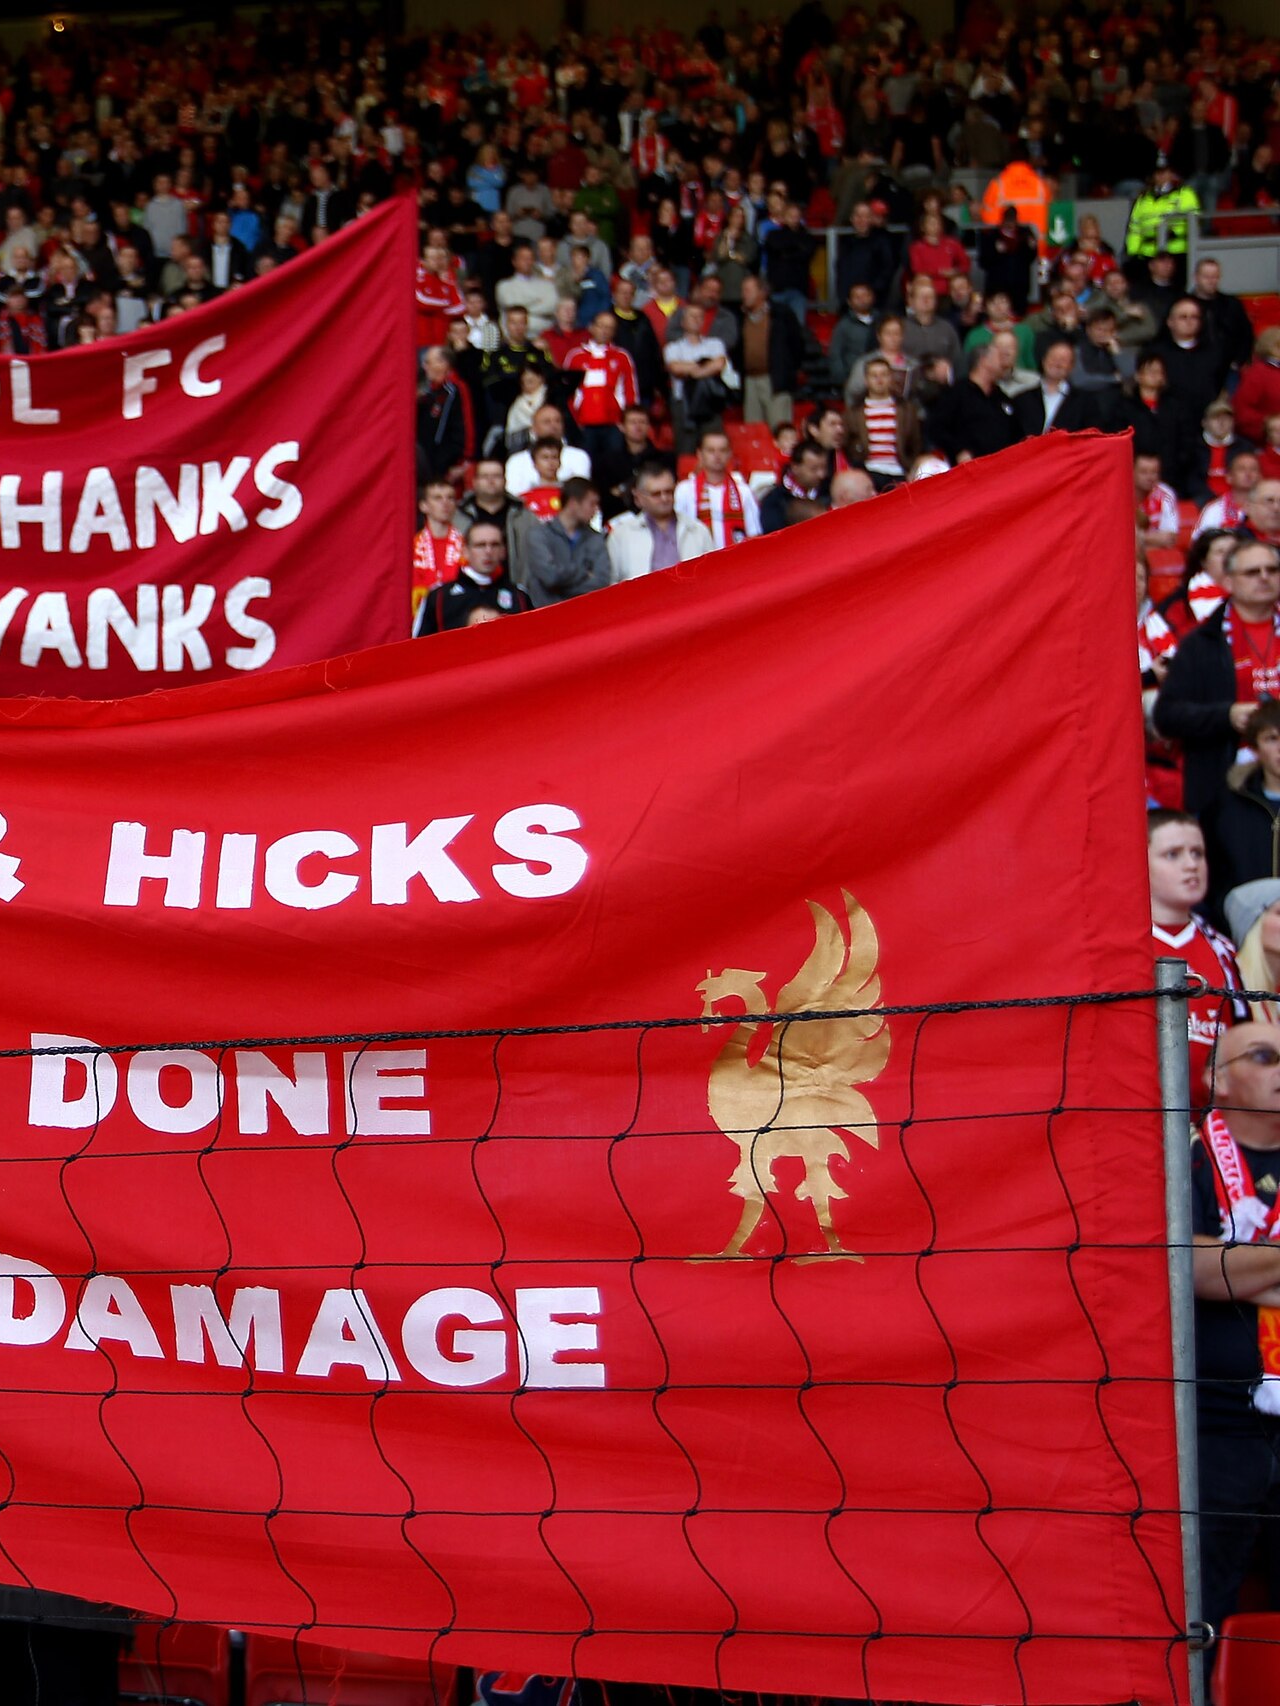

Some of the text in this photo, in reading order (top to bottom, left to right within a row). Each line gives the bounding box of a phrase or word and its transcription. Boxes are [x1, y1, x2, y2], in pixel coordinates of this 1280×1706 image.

[122, 334, 228, 420] FC
[103, 804, 590, 911] HICKS
[29, 1032, 431, 1137] DONE
